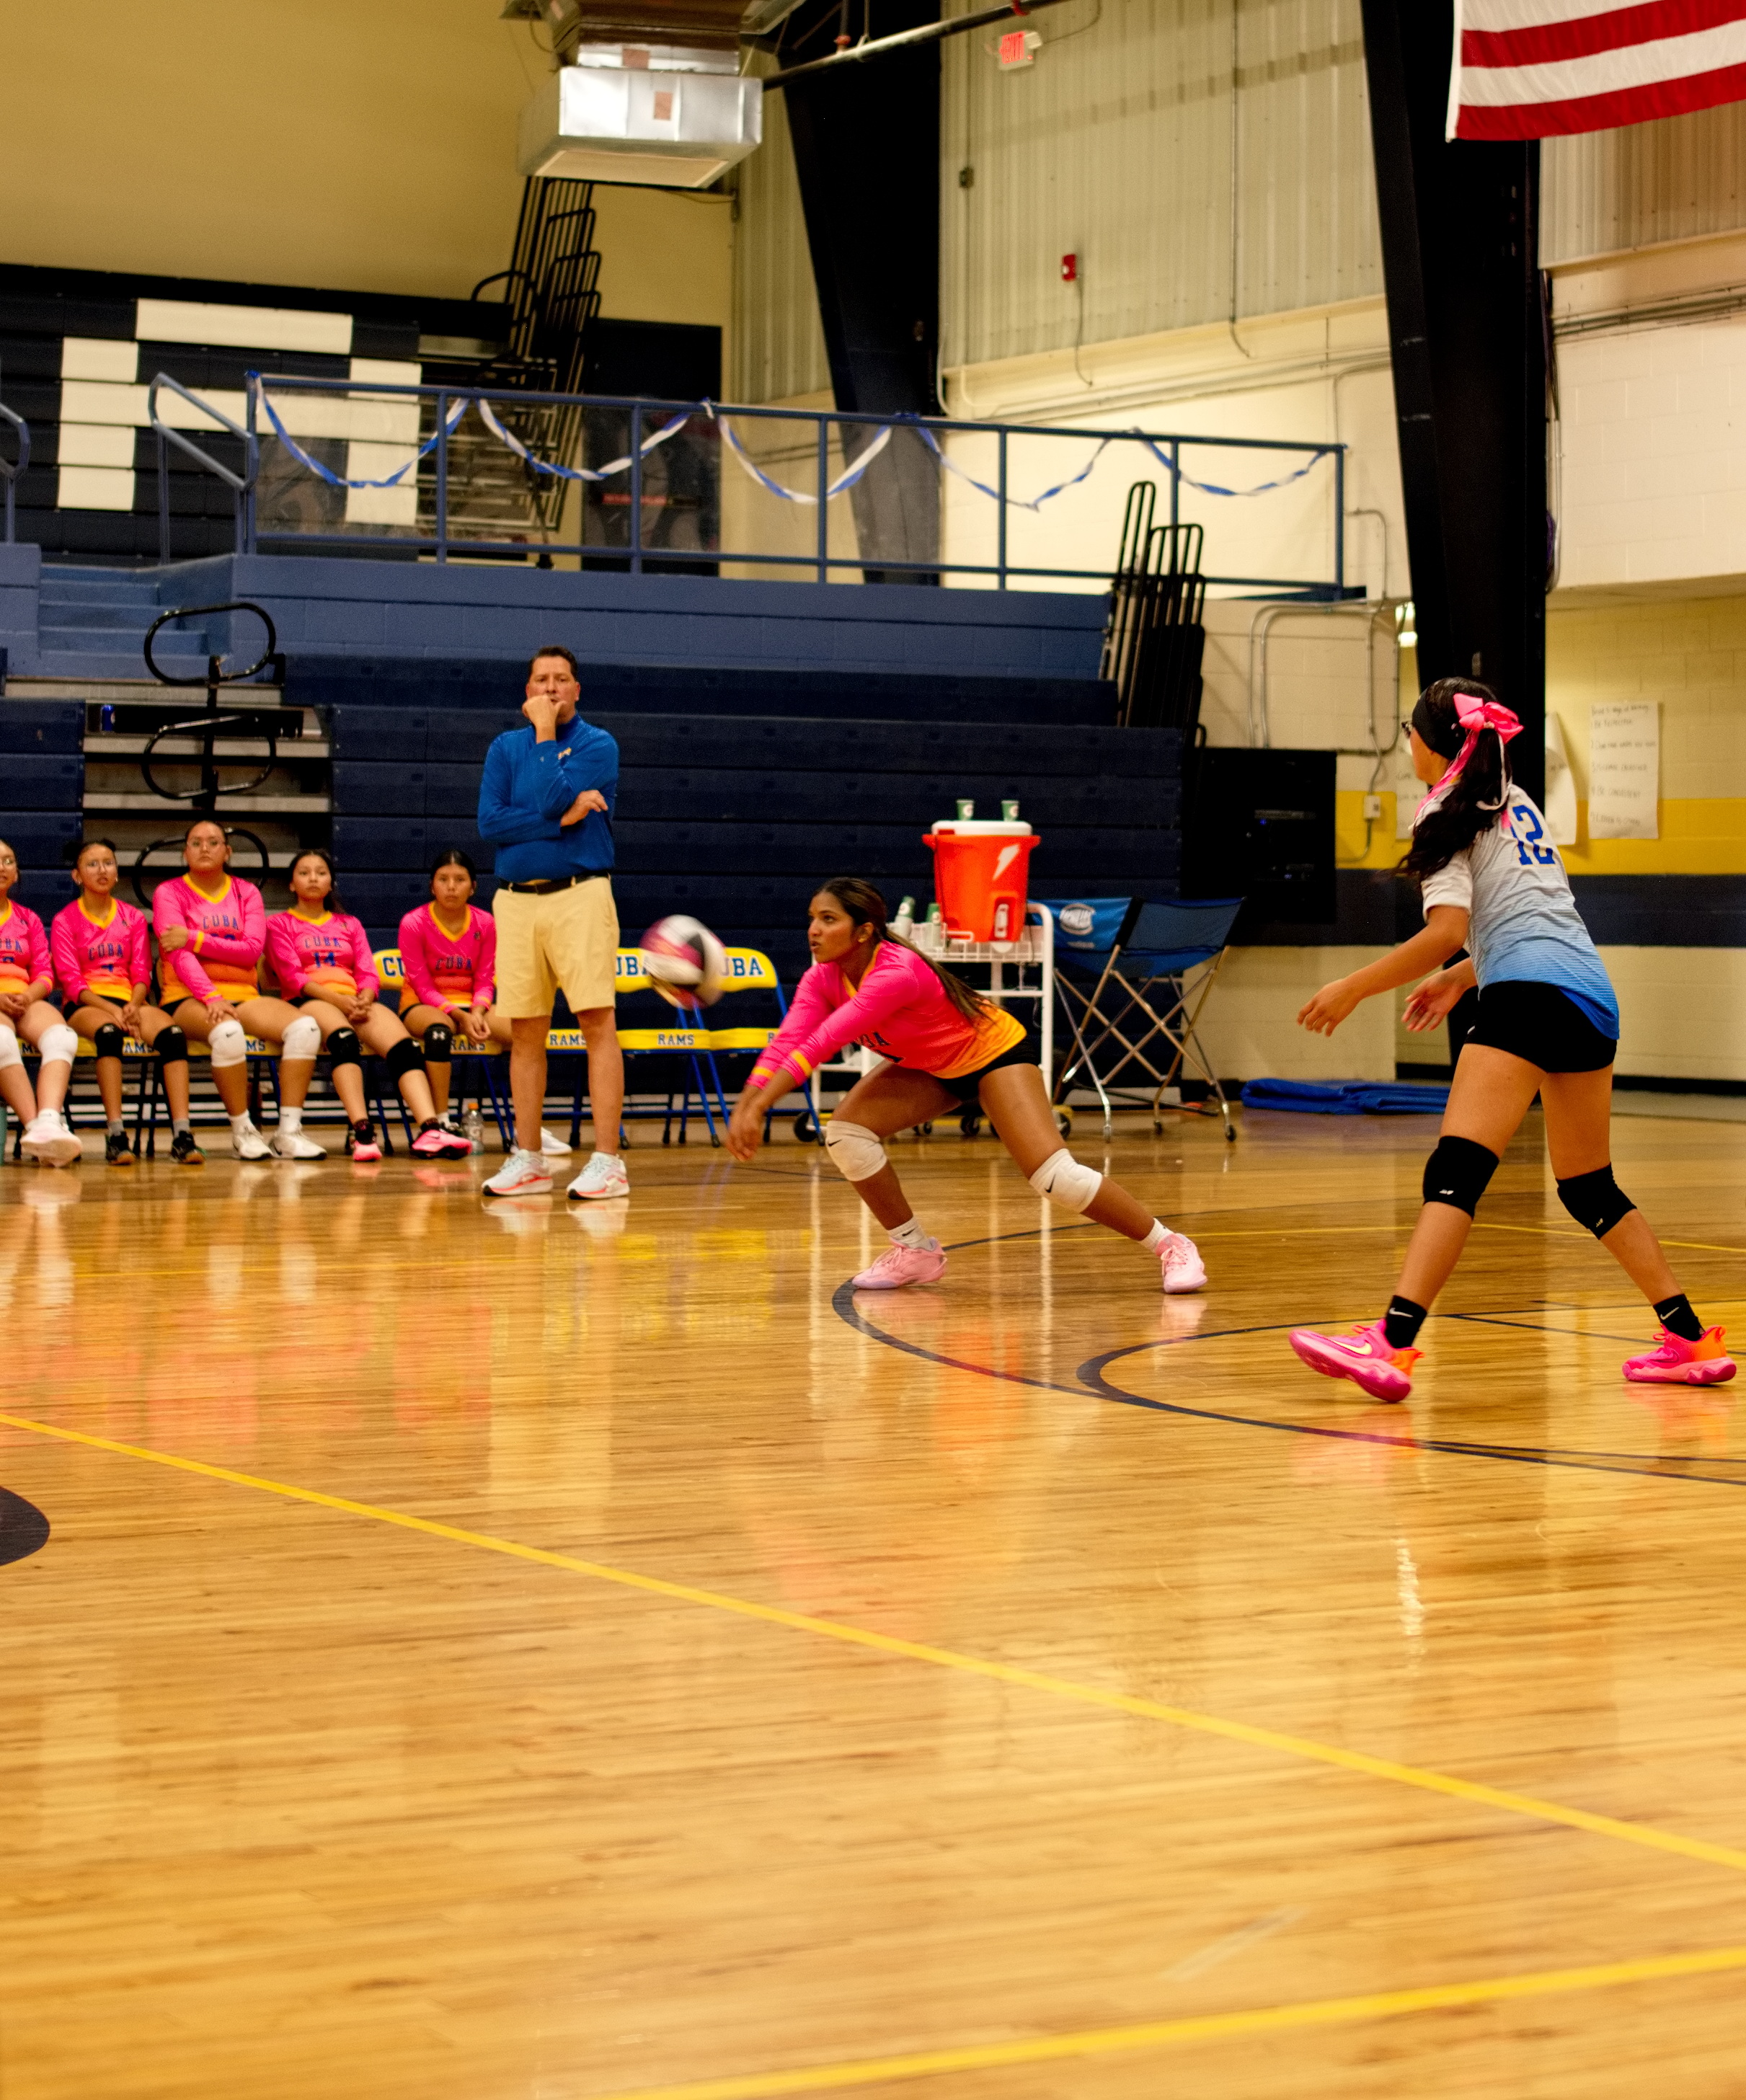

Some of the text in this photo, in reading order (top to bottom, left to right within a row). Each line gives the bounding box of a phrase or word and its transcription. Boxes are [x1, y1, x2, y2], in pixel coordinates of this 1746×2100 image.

[1510, 804, 1556, 866] 12
[203, 914, 239, 931] CUBA
[0, 937, 23, 954] BA
[304, 936, 342, 949] CUBA
[88, 942, 124, 962] CUBA
[313, 951, 337, 968] 14
[435, 954, 473, 972] CUBA
[549, 1032, 586, 1046] RAMS
[657, 1033, 695, 1046] RAMS
